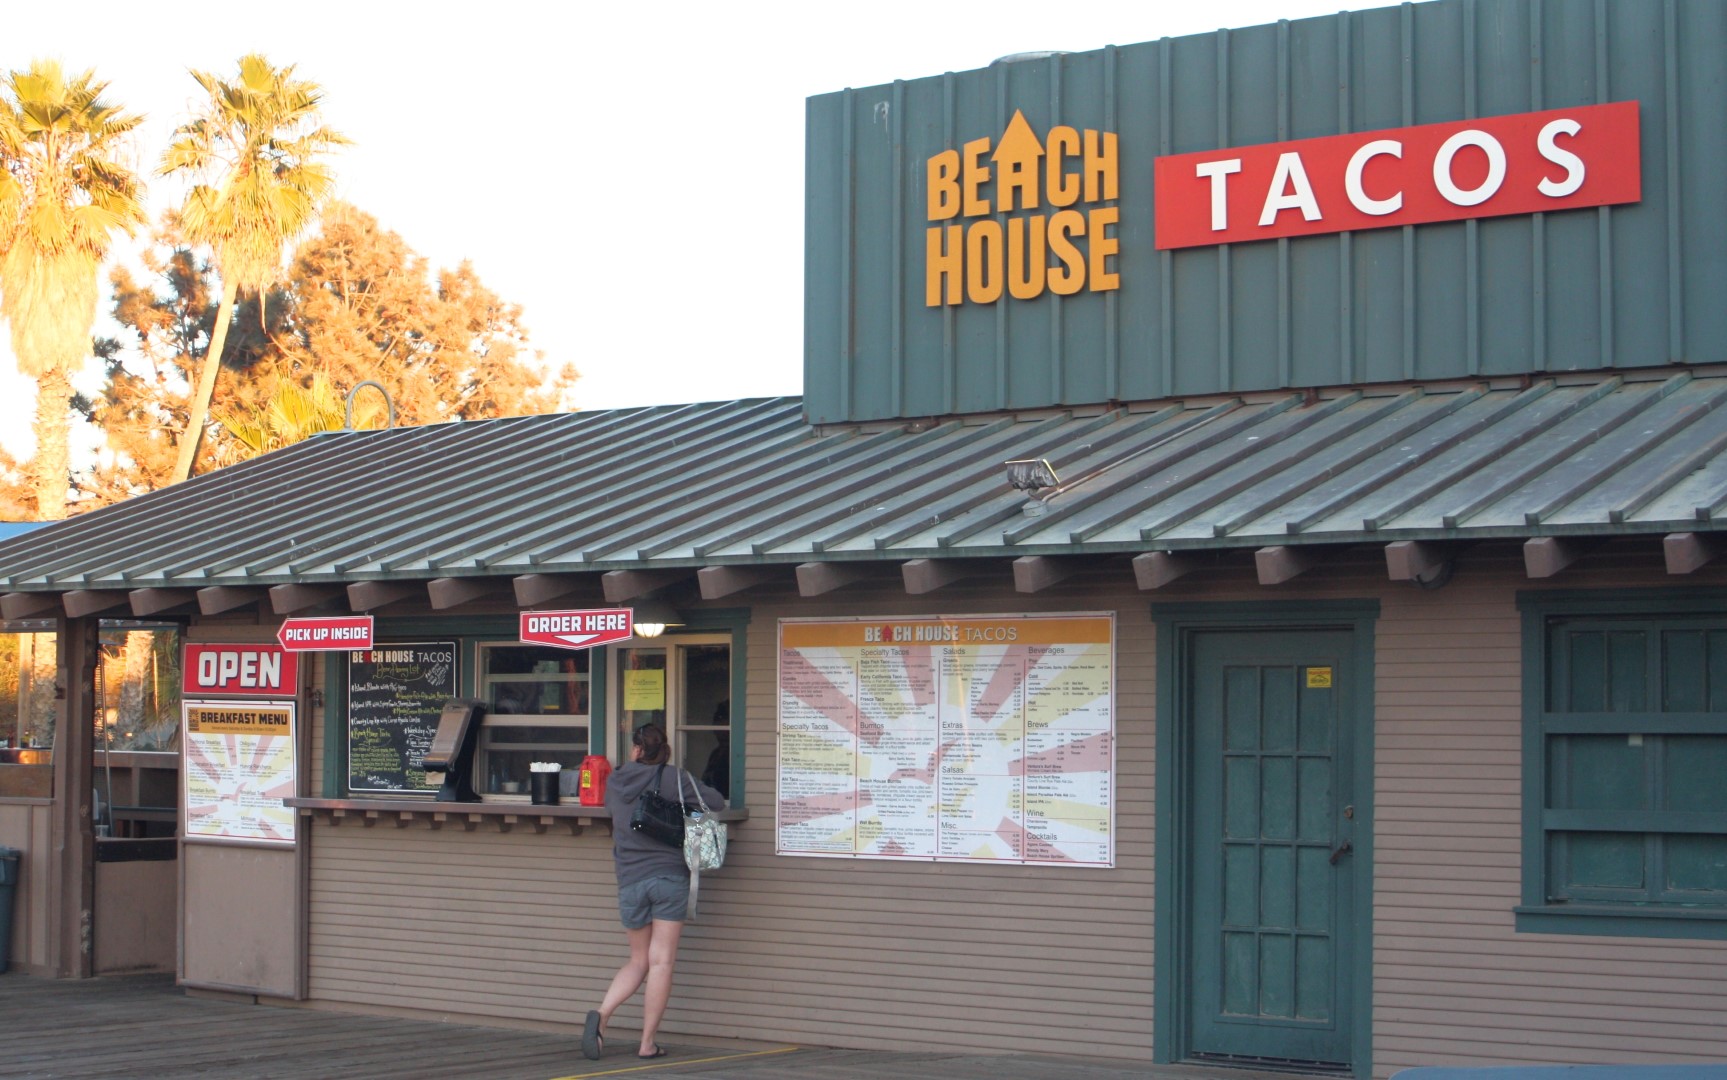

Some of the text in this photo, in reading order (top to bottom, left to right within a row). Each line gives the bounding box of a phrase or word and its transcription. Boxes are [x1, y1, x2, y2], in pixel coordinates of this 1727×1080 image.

[926, 109, 1118, 221] BEACH
[1196, 118, 1584, 231] TACOS
[926, 207, 1119, 307] HOUSE
[528, 614, 626, 633] ORDER HERE
[286, 627, 368, 641] PICK UP INSIDE
[916, 626, 958, 641] HOUSE
[965, 628, 1017, 641] TACOS
[385, 651, 413, 662] HOUSE
[417, 652, 452, 662] TACOS
[198, 651, 281, 688] OPEN
[201, 712, 256, 724] BREAKFAST
[259, 714, 287, 725] MENU
